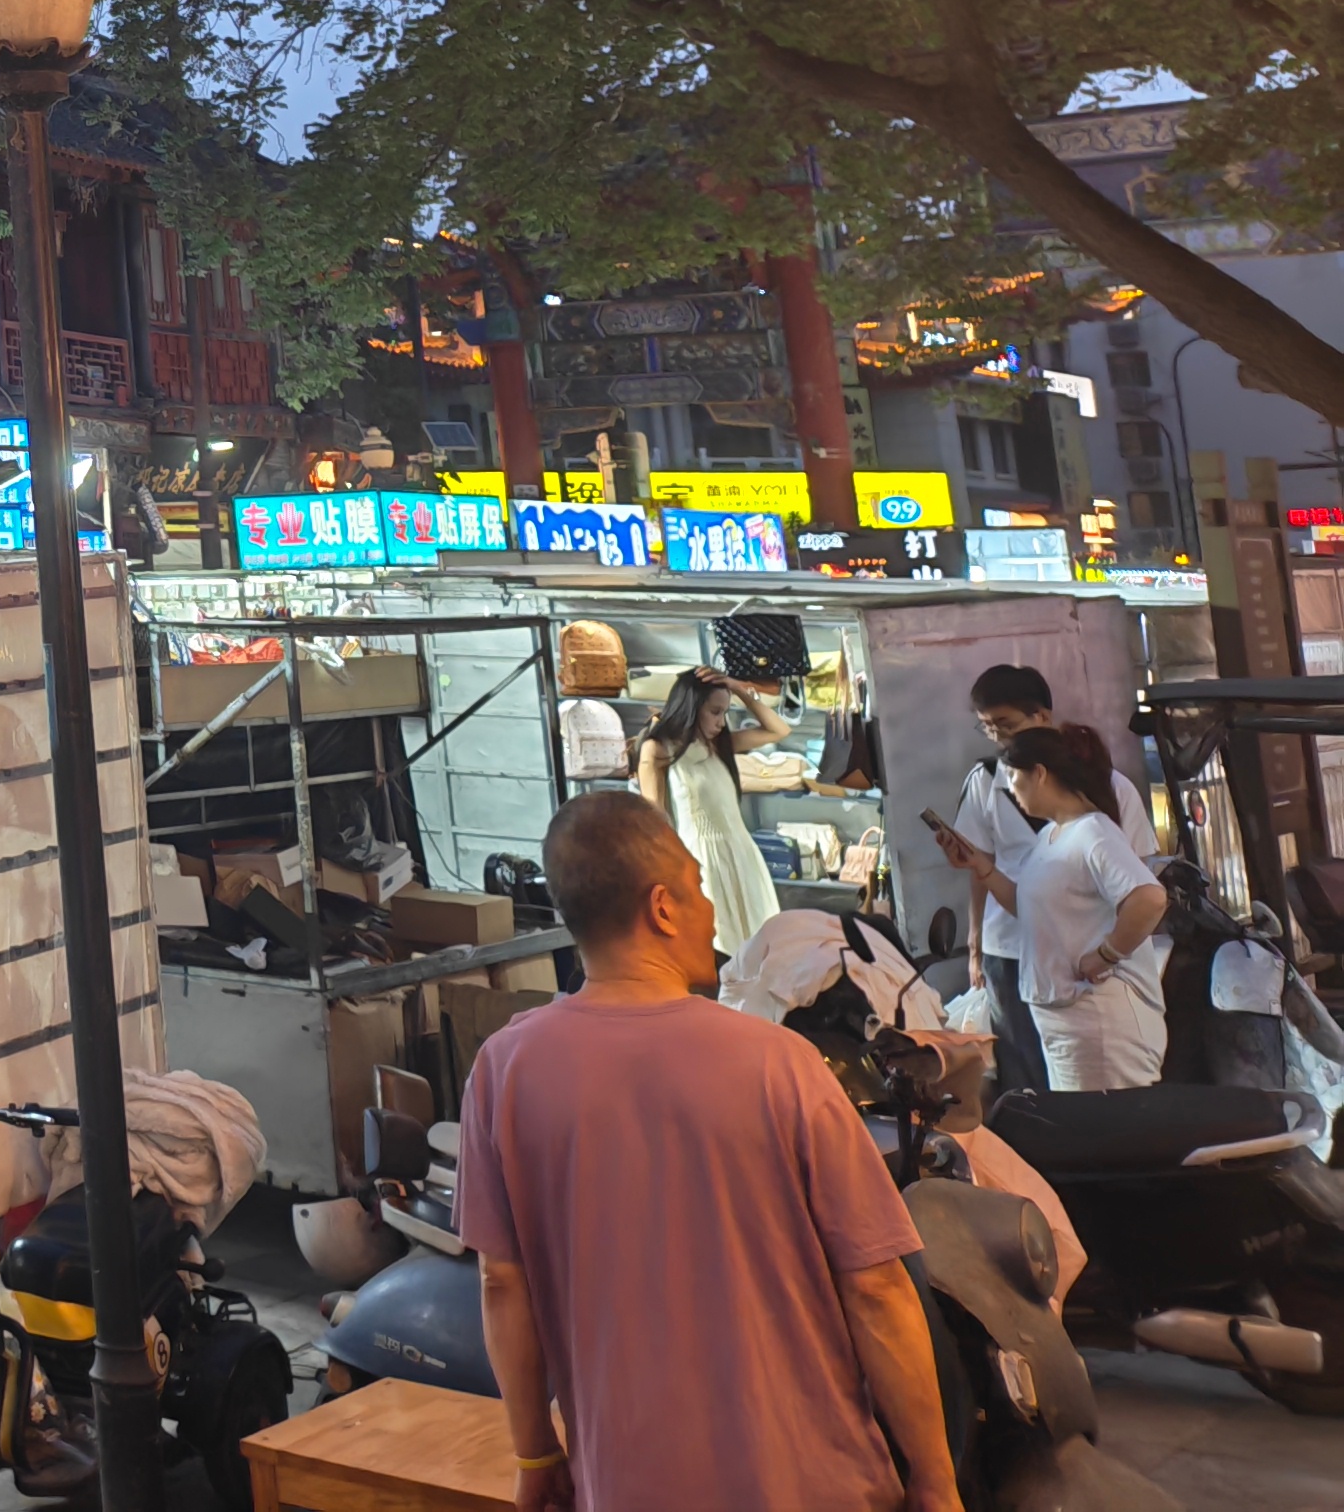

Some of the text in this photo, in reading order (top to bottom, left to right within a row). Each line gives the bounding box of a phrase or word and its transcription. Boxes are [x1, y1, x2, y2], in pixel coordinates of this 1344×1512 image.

[241, 498, 380, 548] 专业贴膜
[388, 498, 506, 548] 专业贴屏保
[886, 500, 918, 520] 9.9
